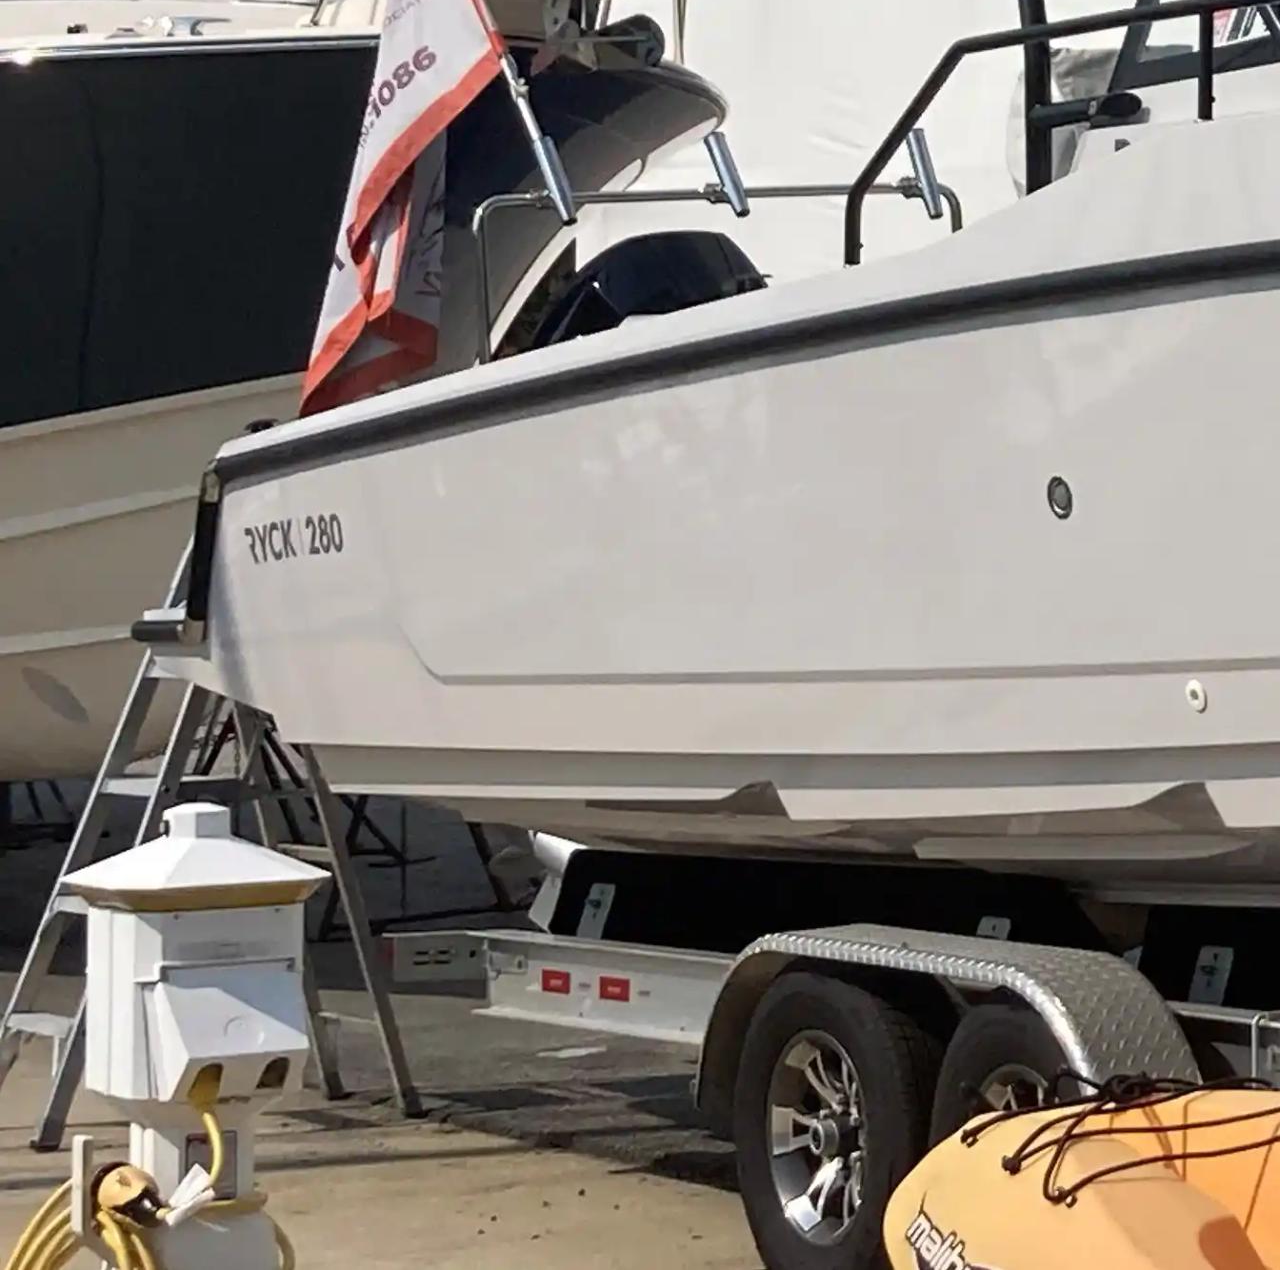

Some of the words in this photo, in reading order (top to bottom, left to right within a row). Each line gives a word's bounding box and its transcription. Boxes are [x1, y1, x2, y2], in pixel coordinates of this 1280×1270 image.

[244, 519, 297, 564] RYCK
[305, 513, 343, 555] 280
[905, 1210, 973, 1270] malib
